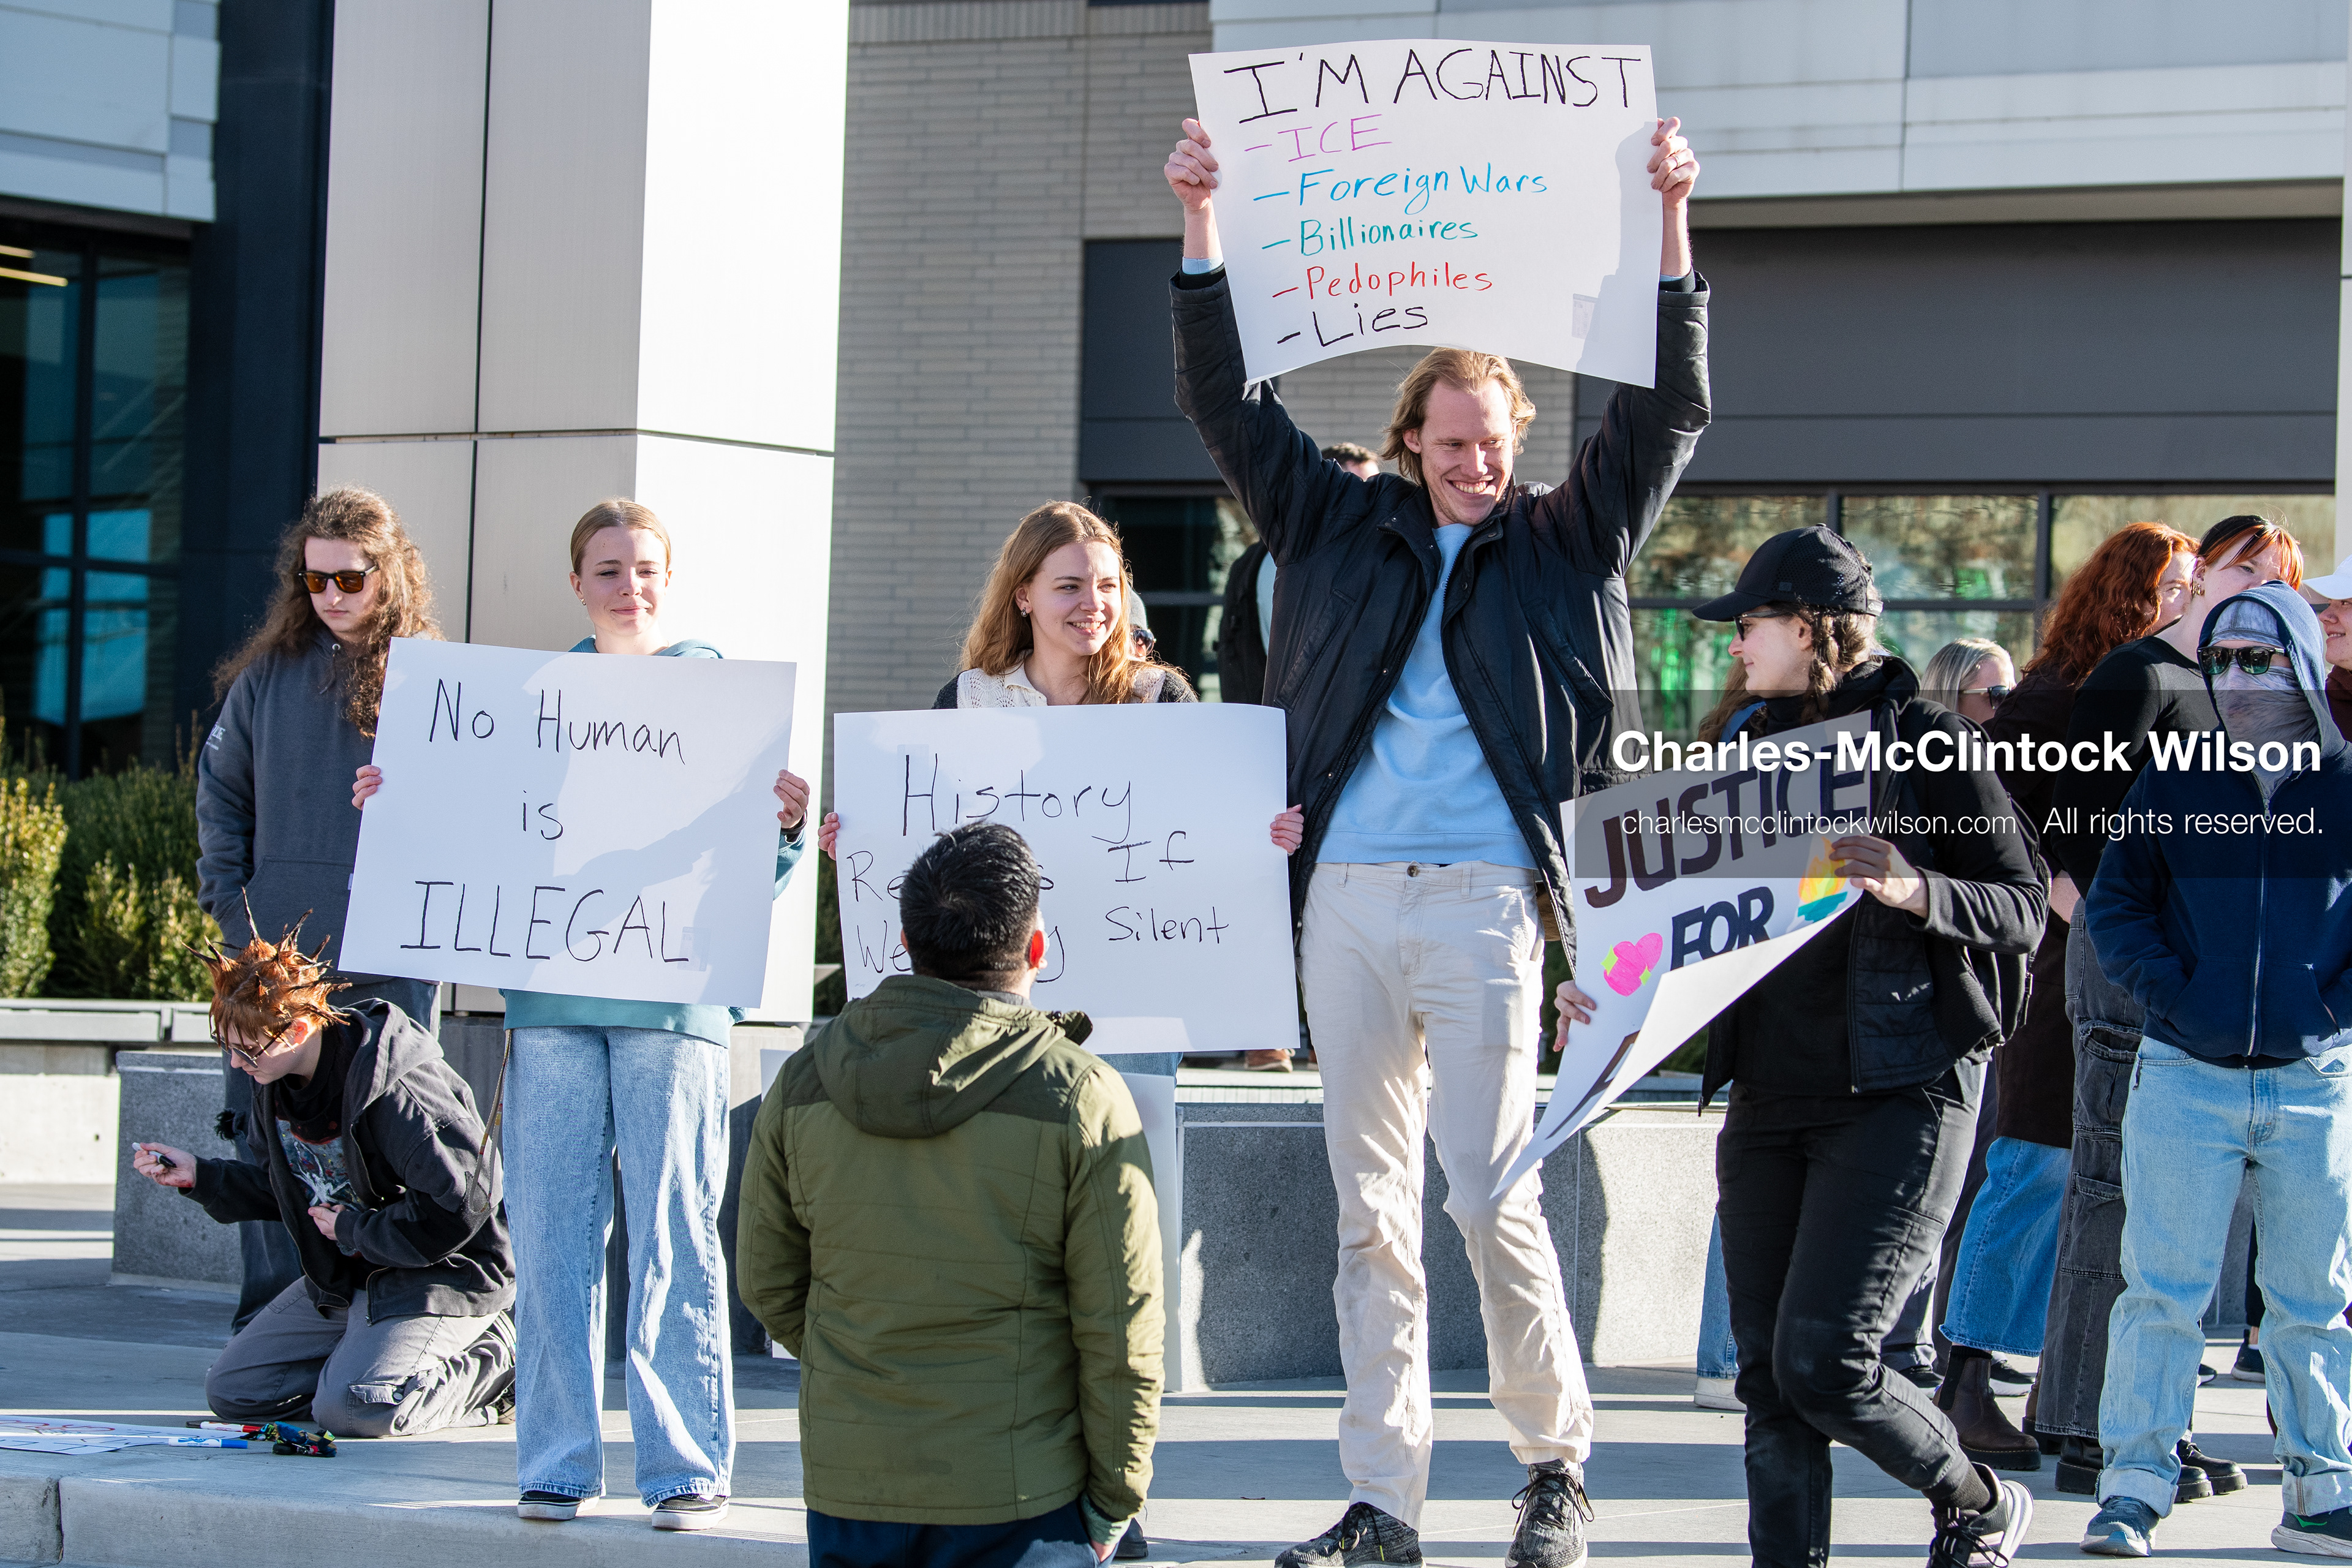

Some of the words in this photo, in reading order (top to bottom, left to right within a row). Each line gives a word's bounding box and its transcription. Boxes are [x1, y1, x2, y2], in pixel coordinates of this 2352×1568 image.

[1223, 52, 1369, 124] I'M
[1393, 48, 1642, 108] AGAINST
[1460, 162, 1548, 194] Wars
[429, 678, 494, 742] No
[537, 688, 686, 765] Human
[522, 790, 564, 840] is
[902, 753, 1131, 844] History
[1584, 736, 1868, 908] JUSTICE
[1107, 831, 1195, 883] If
[400, 880, 689, 963] ILLEGAL
[1105, 906, 1229, 944] Silent
[1670, 886, 1774, 971] FOR
